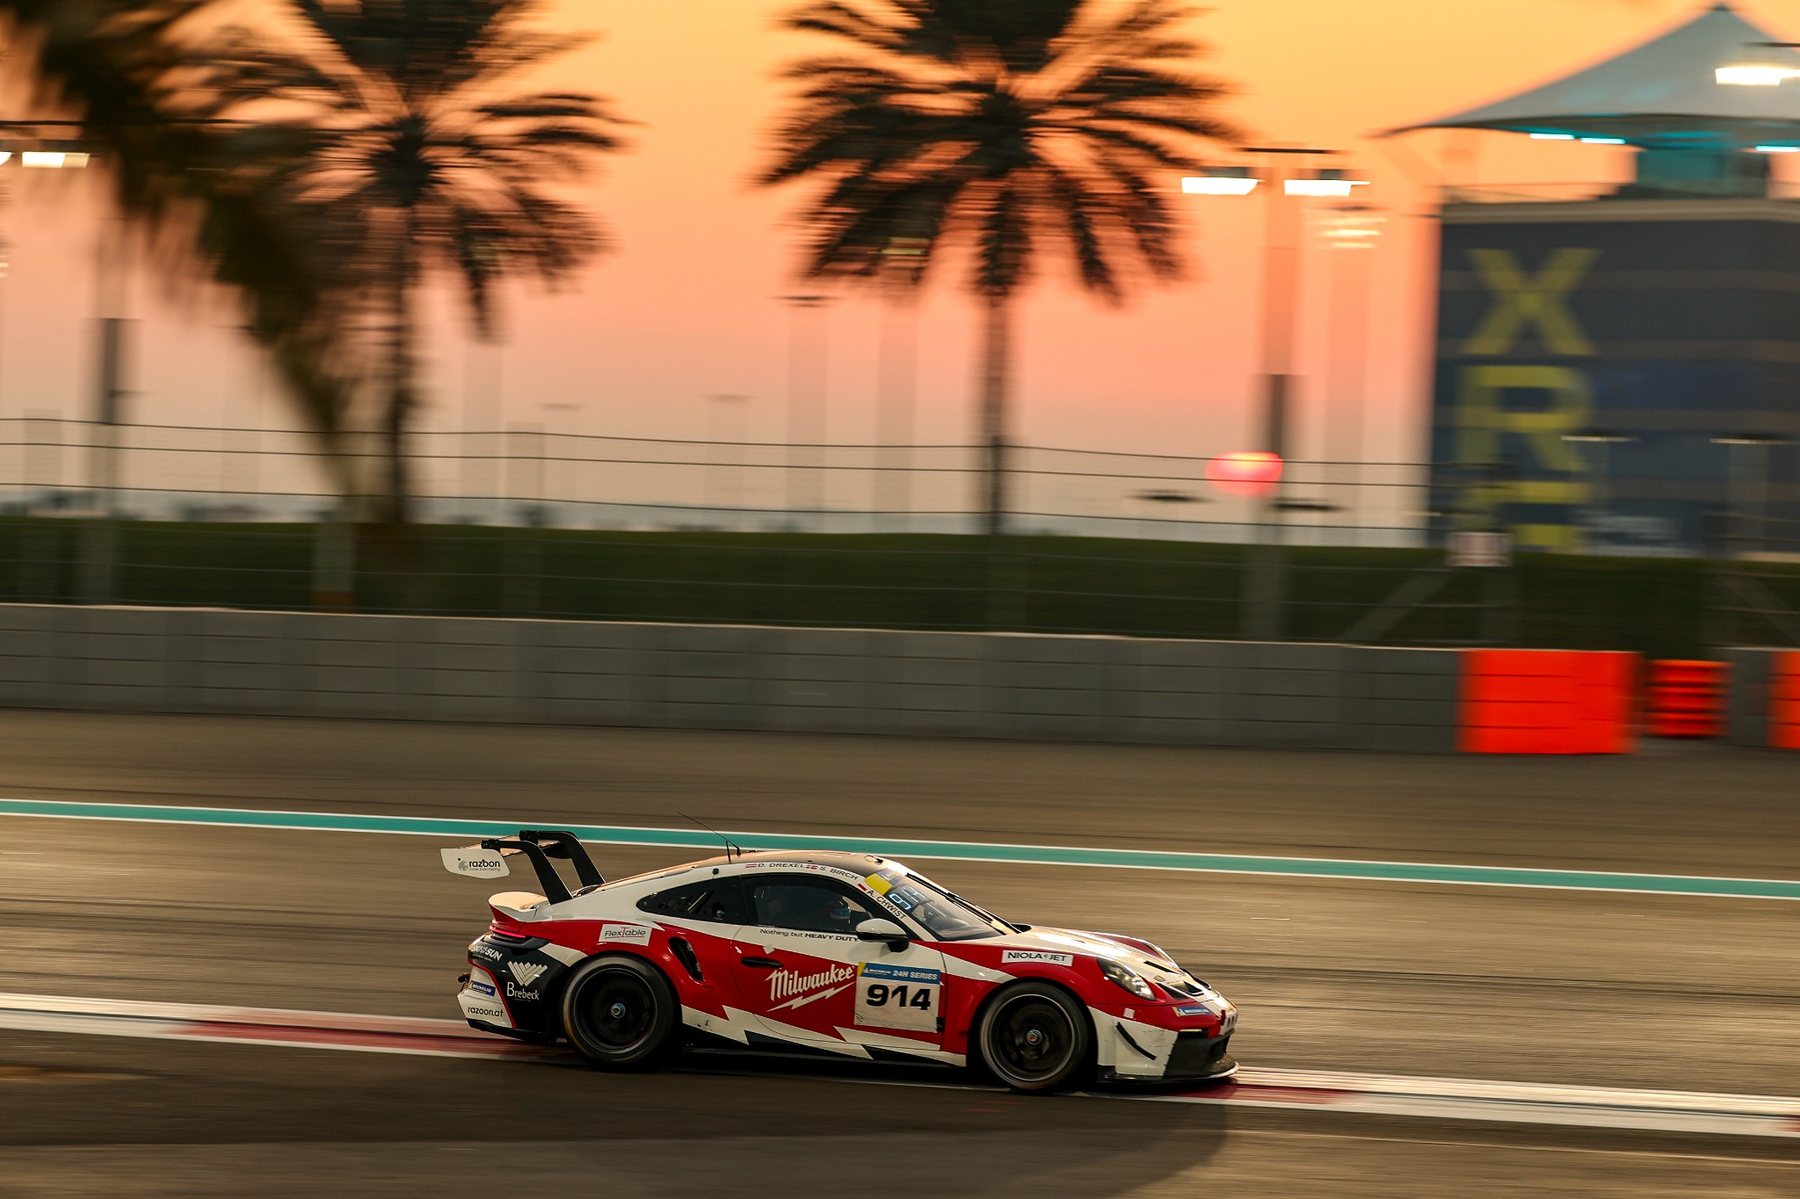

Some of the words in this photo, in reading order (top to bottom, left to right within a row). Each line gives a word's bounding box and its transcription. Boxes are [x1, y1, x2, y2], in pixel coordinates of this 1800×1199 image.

[469, 859, 501, 868] razoon
[830, 868, 859, 881] BIRCH
[877, 896, 907, 920] CHWIST
[604, 927, 647, 938] FlexTable
[760, 929, 790, 937] Nothing
[892, 970, 909, 978] 24H
[909, 971, 938, 980] SERIES
[765, 963, 855, 1002] Milwaukee
[506, 981, 540, 1000] Brebeck
[866, 984, 931, 1010] 914
[467, 1006, 504, 1017] razoon.at
